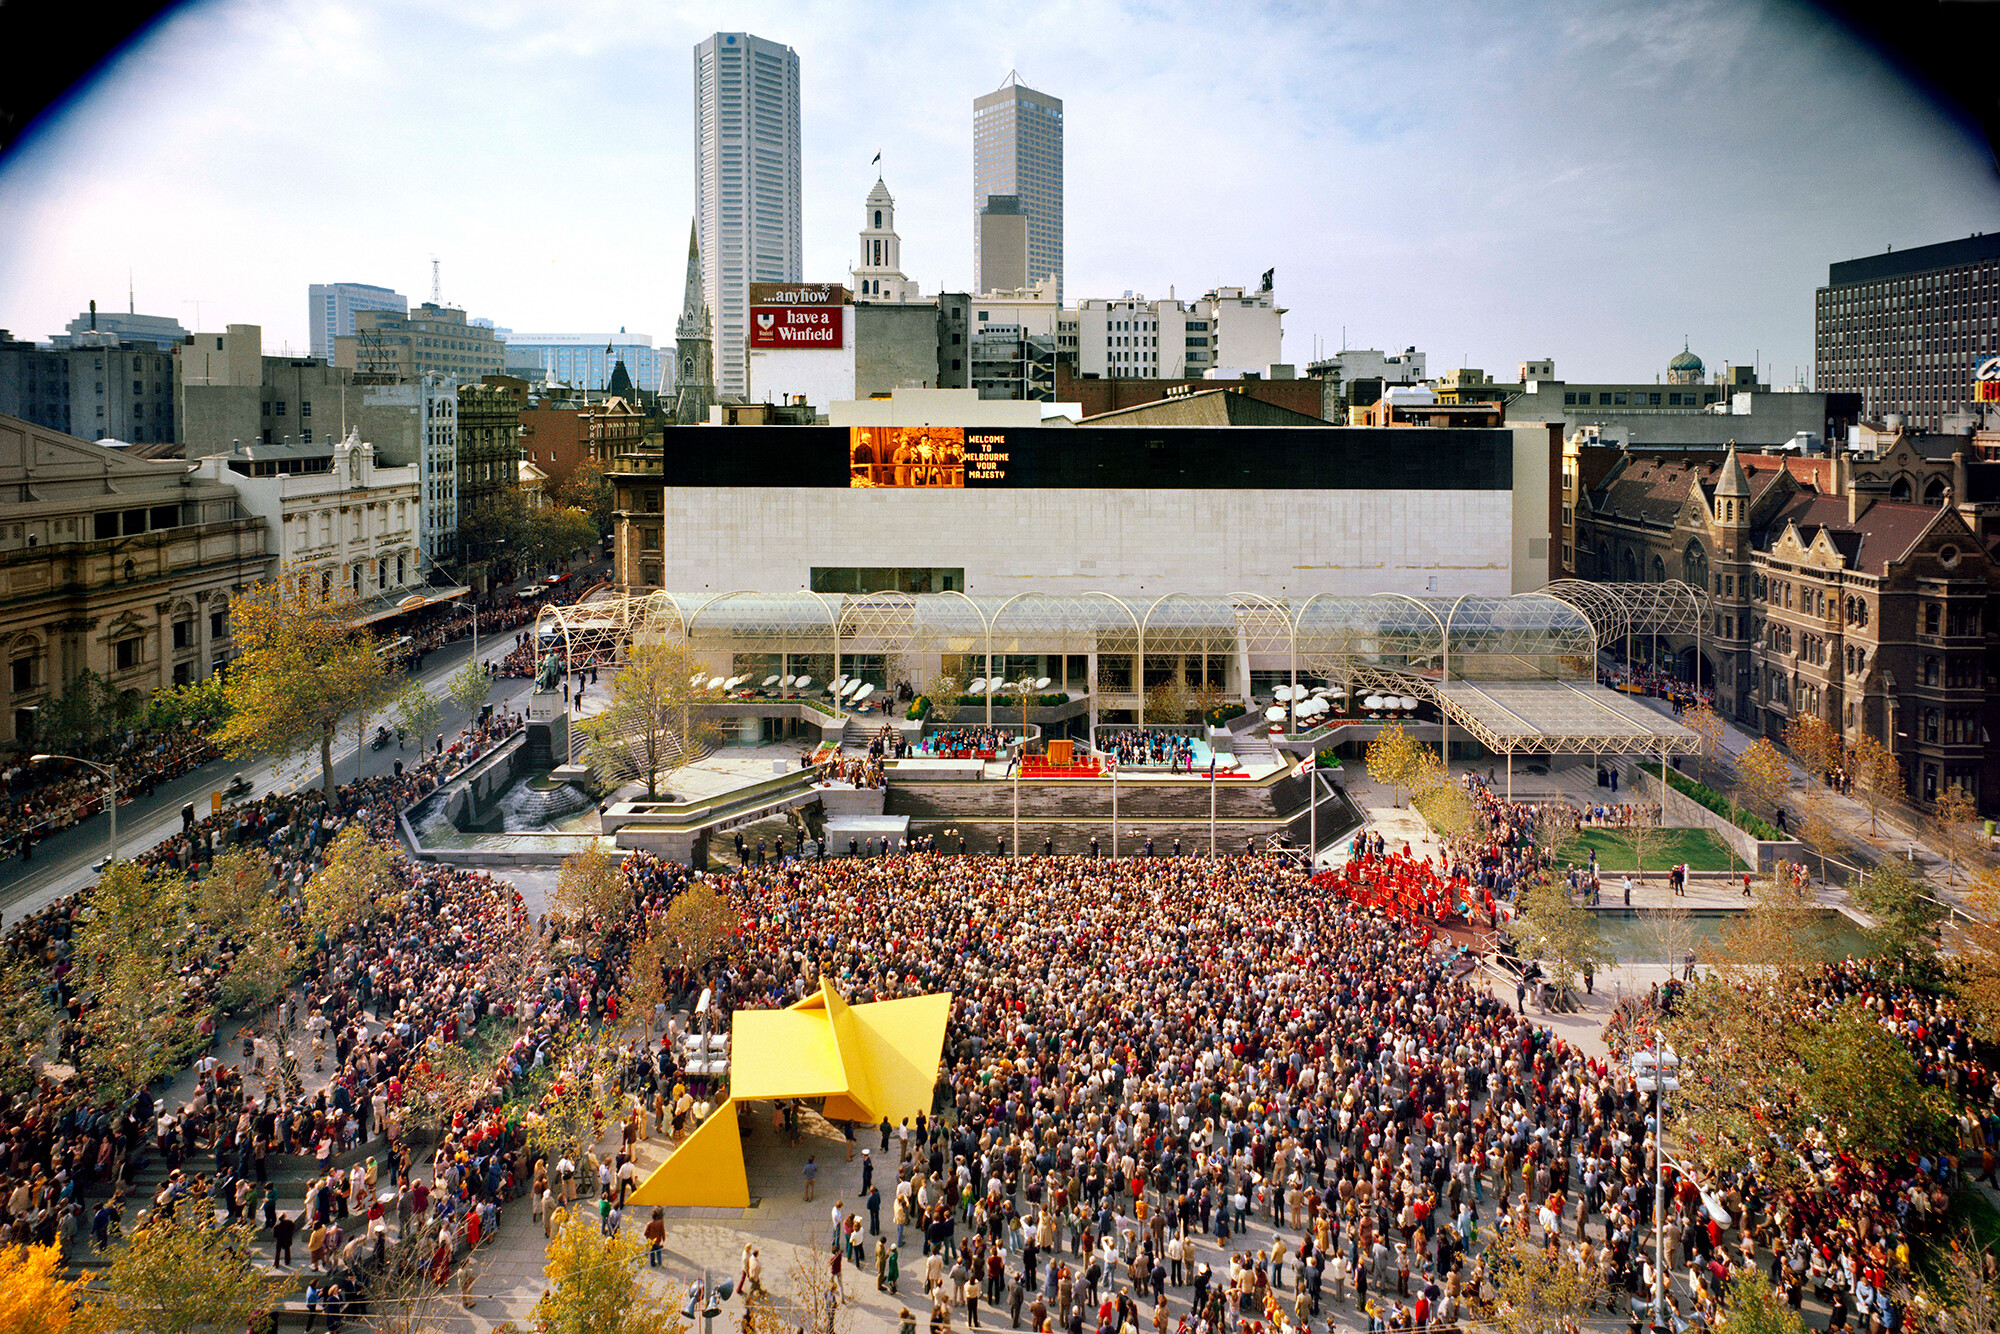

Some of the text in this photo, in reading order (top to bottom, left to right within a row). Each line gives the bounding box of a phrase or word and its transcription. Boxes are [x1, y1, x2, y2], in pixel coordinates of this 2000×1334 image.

[787, 310, 829, 323] have a
[778, 327, 833, 340] Winfield
[969, 435, 1005, 443] WELCOME
[981, 444, 992, 452] TO
[964, 453, 1009, 461] MELBOURNE
[976, 462, 997, 470] YOUR
[380, 536, 405, 546] LIBRARY
[300, 551, 333, 562] LENDING
